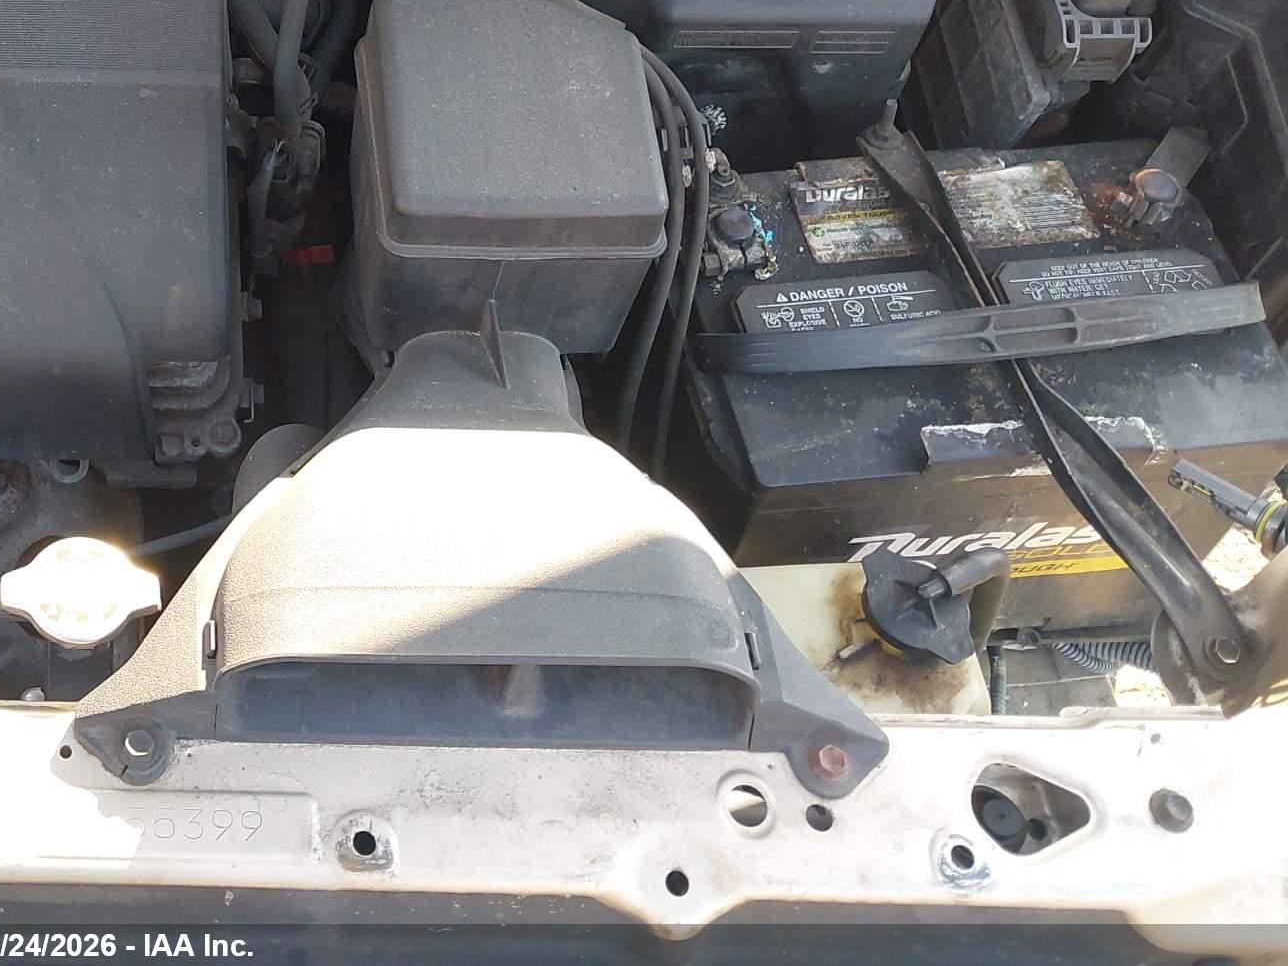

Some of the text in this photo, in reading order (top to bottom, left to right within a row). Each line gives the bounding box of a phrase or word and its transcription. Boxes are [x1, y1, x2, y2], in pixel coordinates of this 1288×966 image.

[806, 185, 890, 203] Duralas
[1045, 274, 1133, 287] FLUSH EYES IMMEDIATELY
[790, 282, 908, 302] DANGER / POISON
[1047, 286, 1066, 294] WITH
[1094, 283, 1108, 291] GET
[800, 306, 825, 314] SHIELD
[890, 311, 924, 320] SULFURIC
[789, 318, 827, 328] EXPLOSIVE
[846, 521, 1103, 569] Duralas
